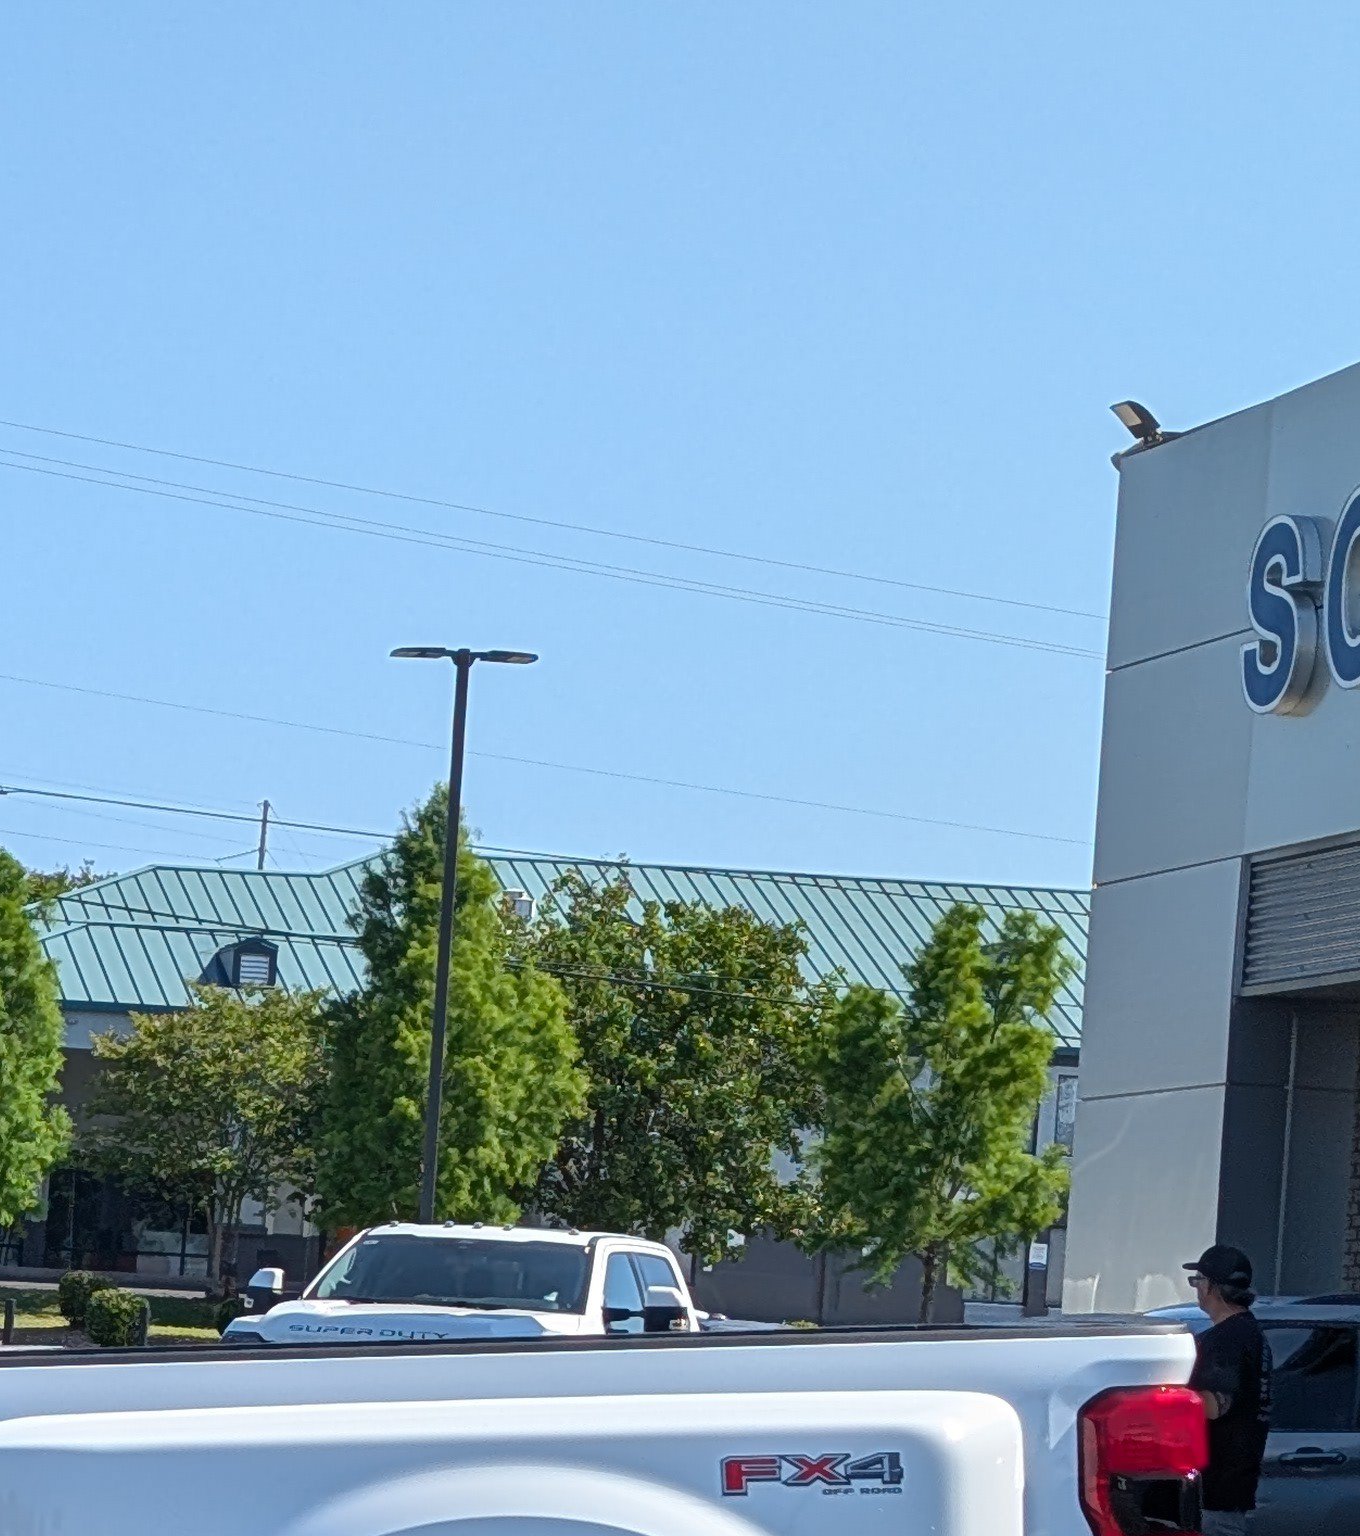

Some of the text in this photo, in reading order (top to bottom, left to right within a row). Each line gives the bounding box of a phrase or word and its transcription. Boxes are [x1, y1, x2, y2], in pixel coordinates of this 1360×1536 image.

[289, 1324, 451, 1340] SUPER DUTY
[720, 1452, 905, 1496] FX4
[823, 1486, 903, 1496] OFF ROAD
